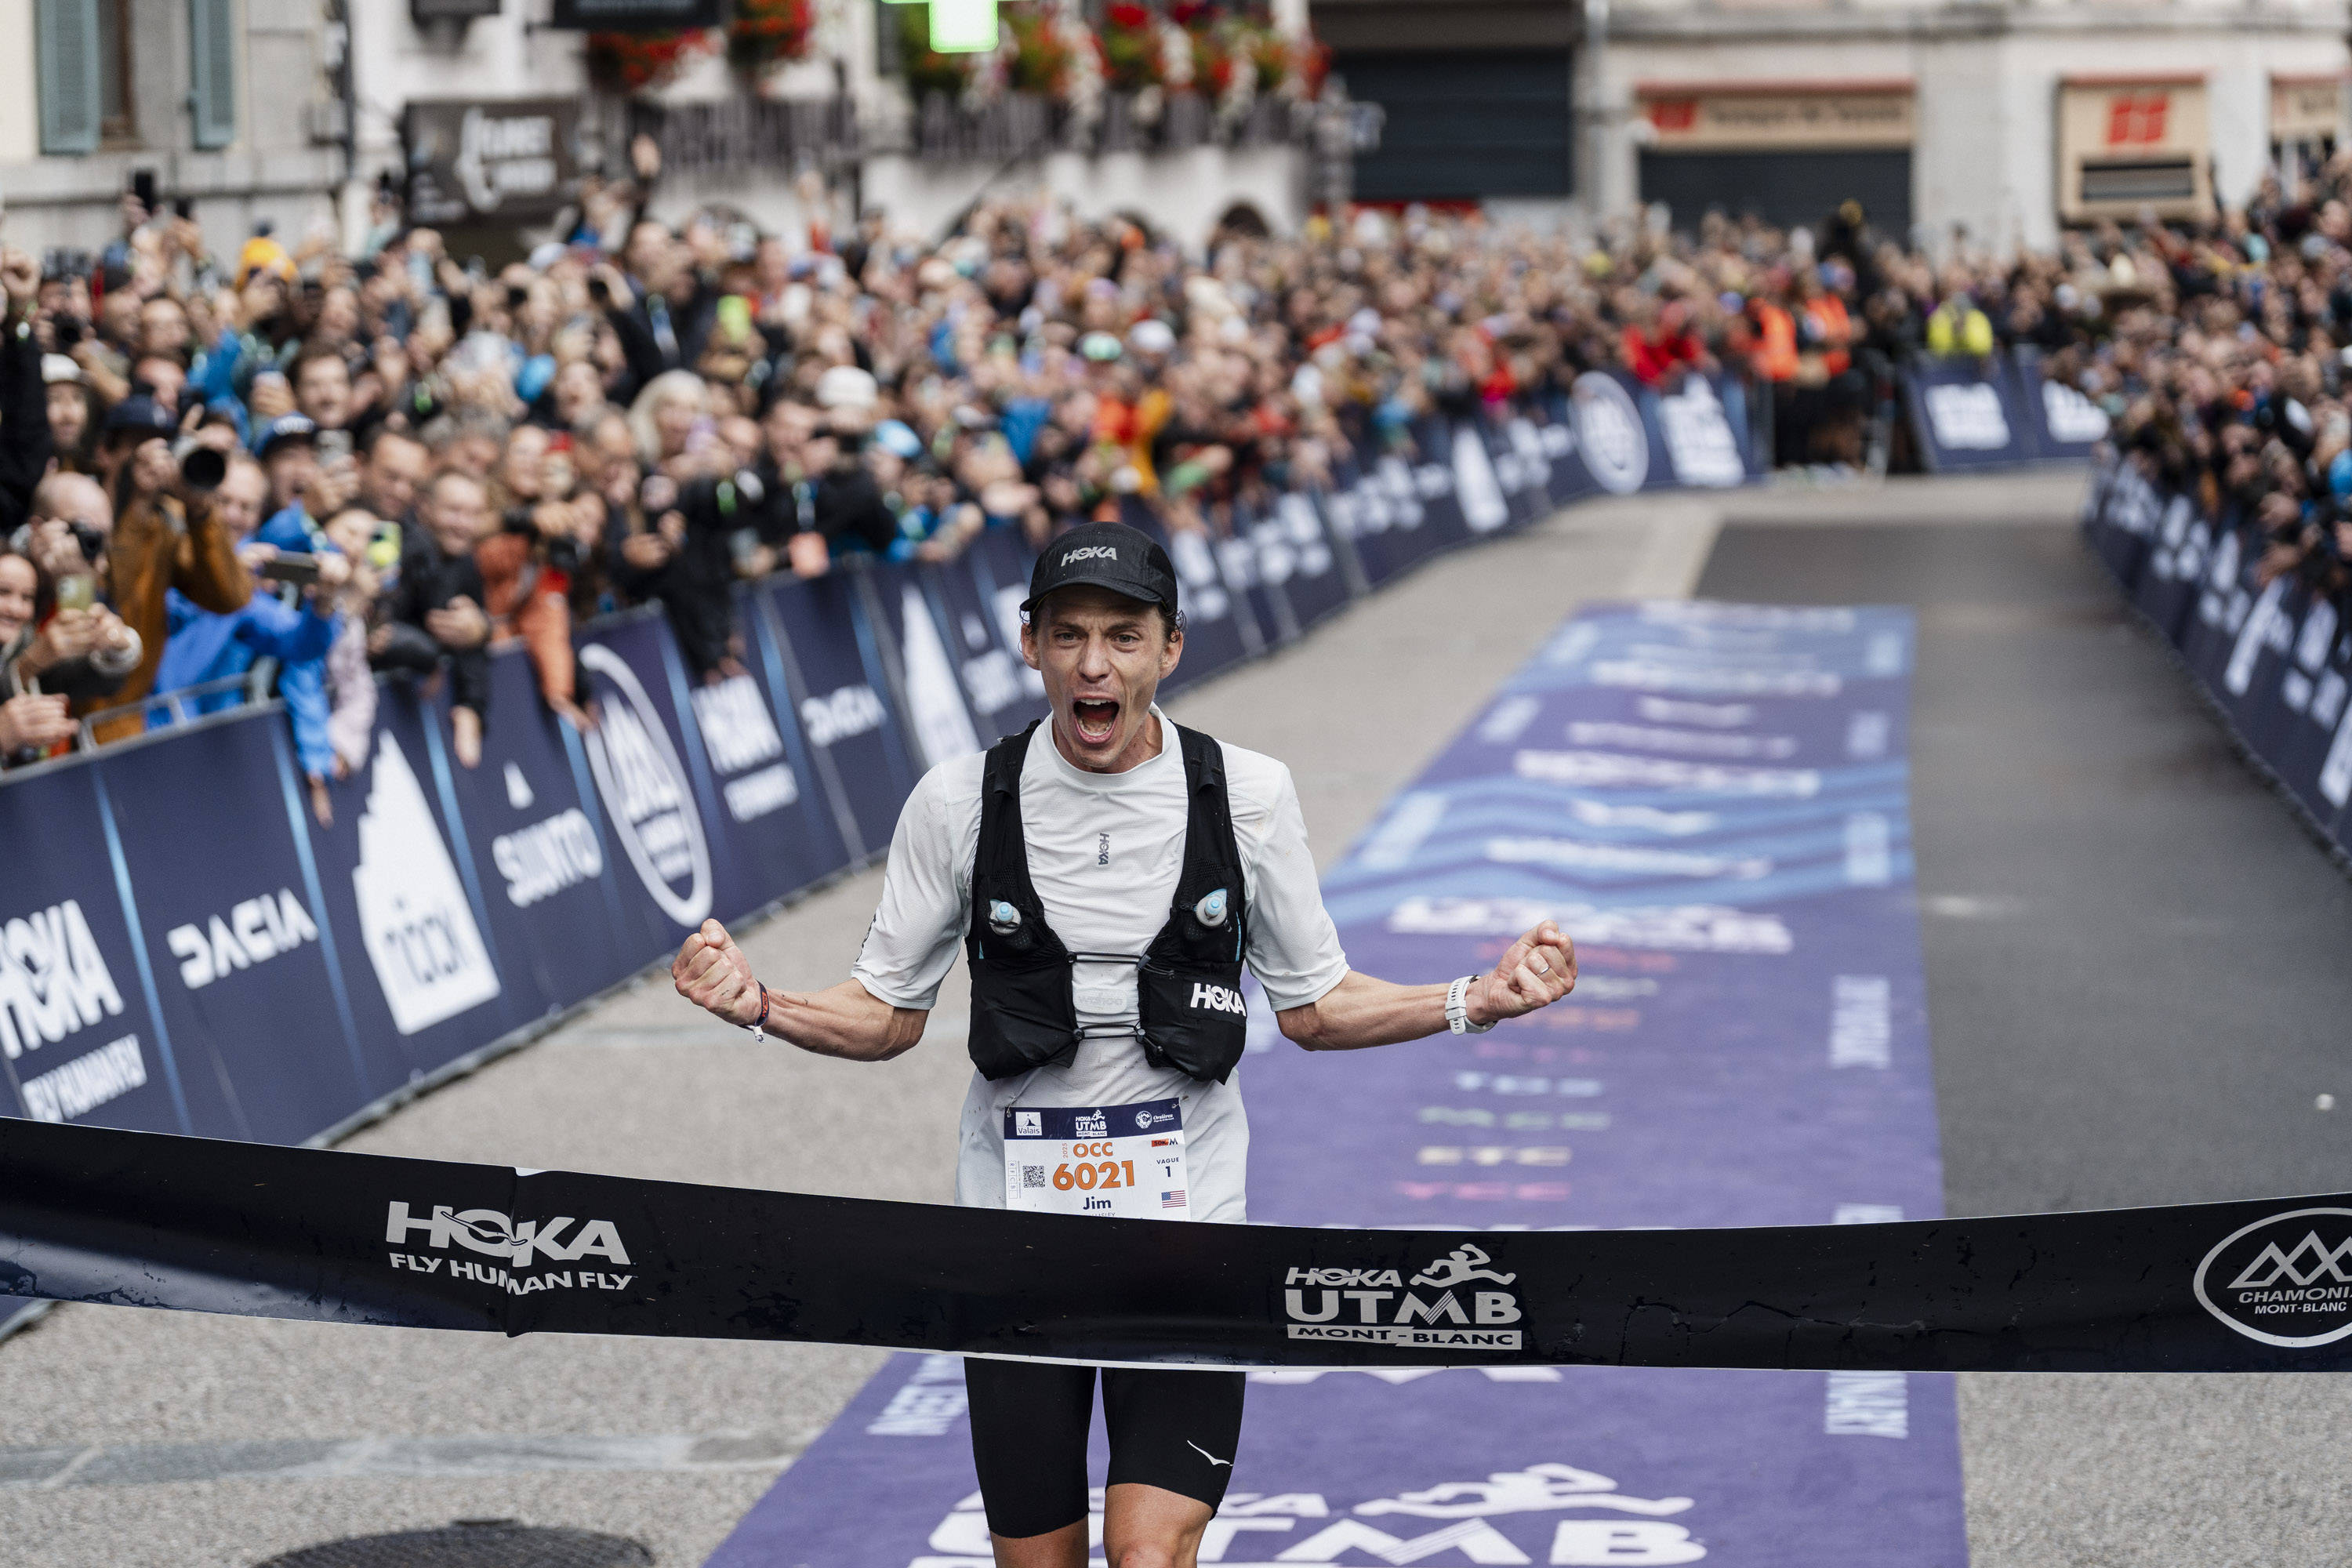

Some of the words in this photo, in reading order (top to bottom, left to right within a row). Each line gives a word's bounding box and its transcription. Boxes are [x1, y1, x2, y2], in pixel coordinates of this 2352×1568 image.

[1061, 546, 1117, 567] HOKA
[1098, 833, 1109, 866] HOKA
[167, 887, 318, 989] DACIA
[1190, 982, 1247, 1017] HOKA
[1076, 1121, 1107, 1131] UTMB
[1073, 1142, 1113, 1158] OCC
[1156, 1156, 1180, 1165] VAGUE
[1053, 1160, 1135, 1191] 6021
[1165, 1166, 1171, 1178] 1
[1083, 1196, 1112, 1210] Jim
[386, 1200, 631, 1268] HOKA
[389, 1252, 443, 1273] FLY
[446, 1259, 573, 1296] HUMAN
[579, 1271, 633, 1290] FLY
[1285, 1267, 1403, 1287] HOKA
[2238, 1286, 2352, 1304] CHAMONI
[1285, 1289, 1523, 1326] UTMB
[2254, 1301, 2347, 1315] MONT-BLANC
